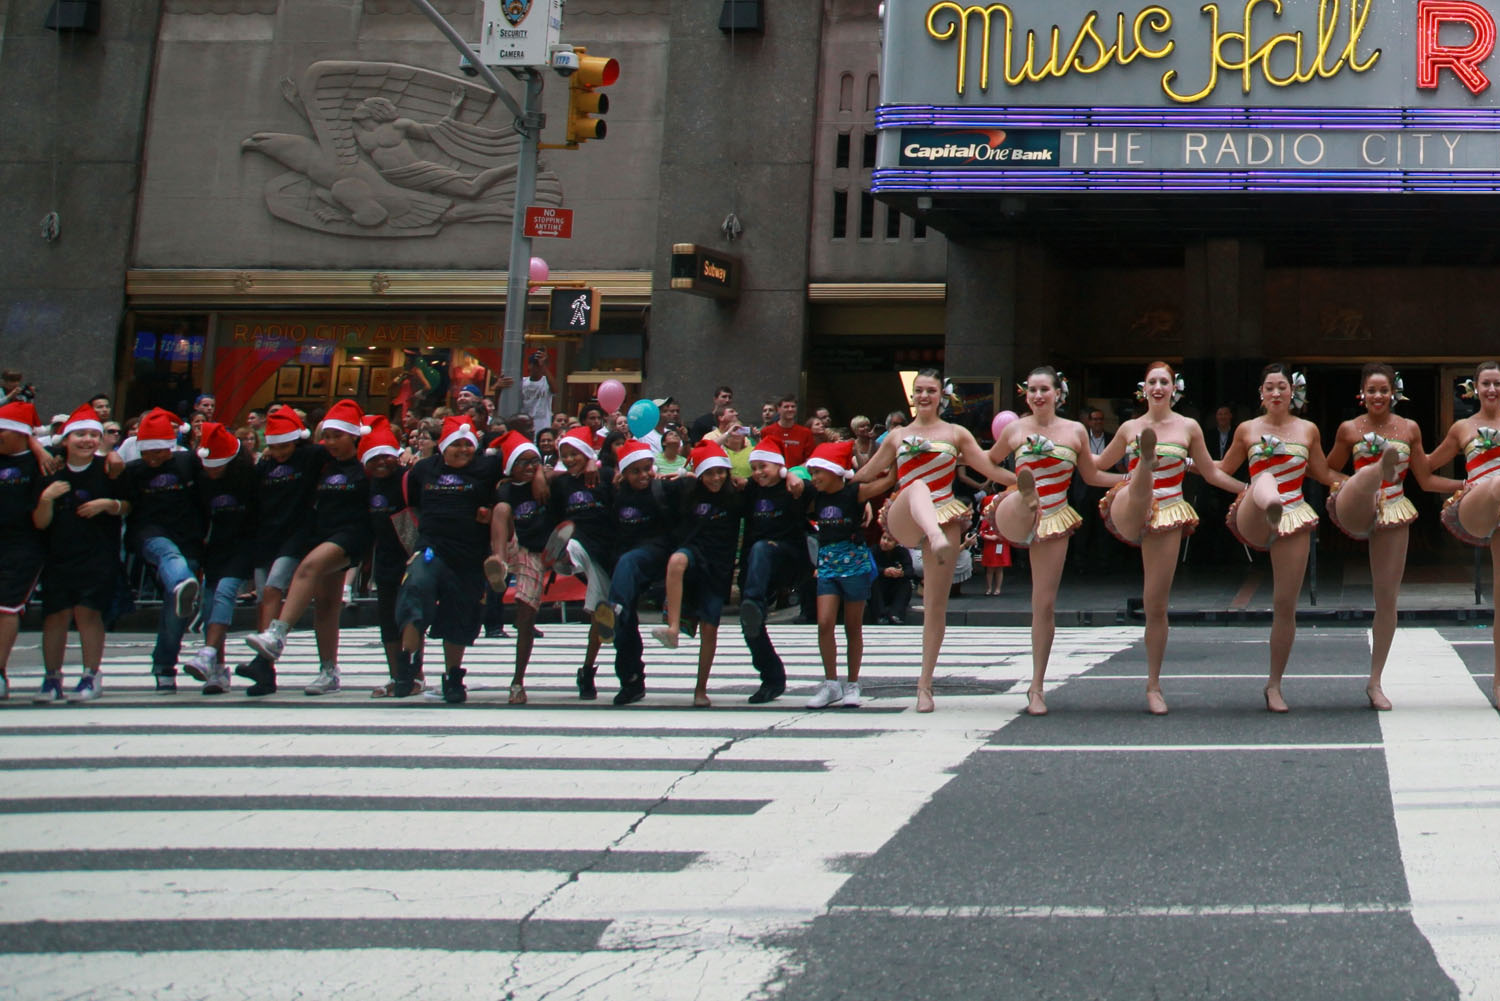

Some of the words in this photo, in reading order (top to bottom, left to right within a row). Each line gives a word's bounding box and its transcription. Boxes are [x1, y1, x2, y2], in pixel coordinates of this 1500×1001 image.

[499, 49, 525, 59] CAMERA
[926, 2, 1174, 95] Music
[1011, 149, 1053, 160] Bank
[1065, 132, 1144, 165] THE
[1185, 132, 1326, 166] RADIO
[1361, 133, 1462, 166] CITY
[543, 208, 556, 217] NO
[534, 216, 564, 225] STOPPING
[535, 223, 562, 231] ANYTIME
[703, 260, 727, 283] Subway
[233, 324, 307, 342] RADIO
[313, 325, 367, 343] CITY
[374, 325, 459, 343] AVENUE
